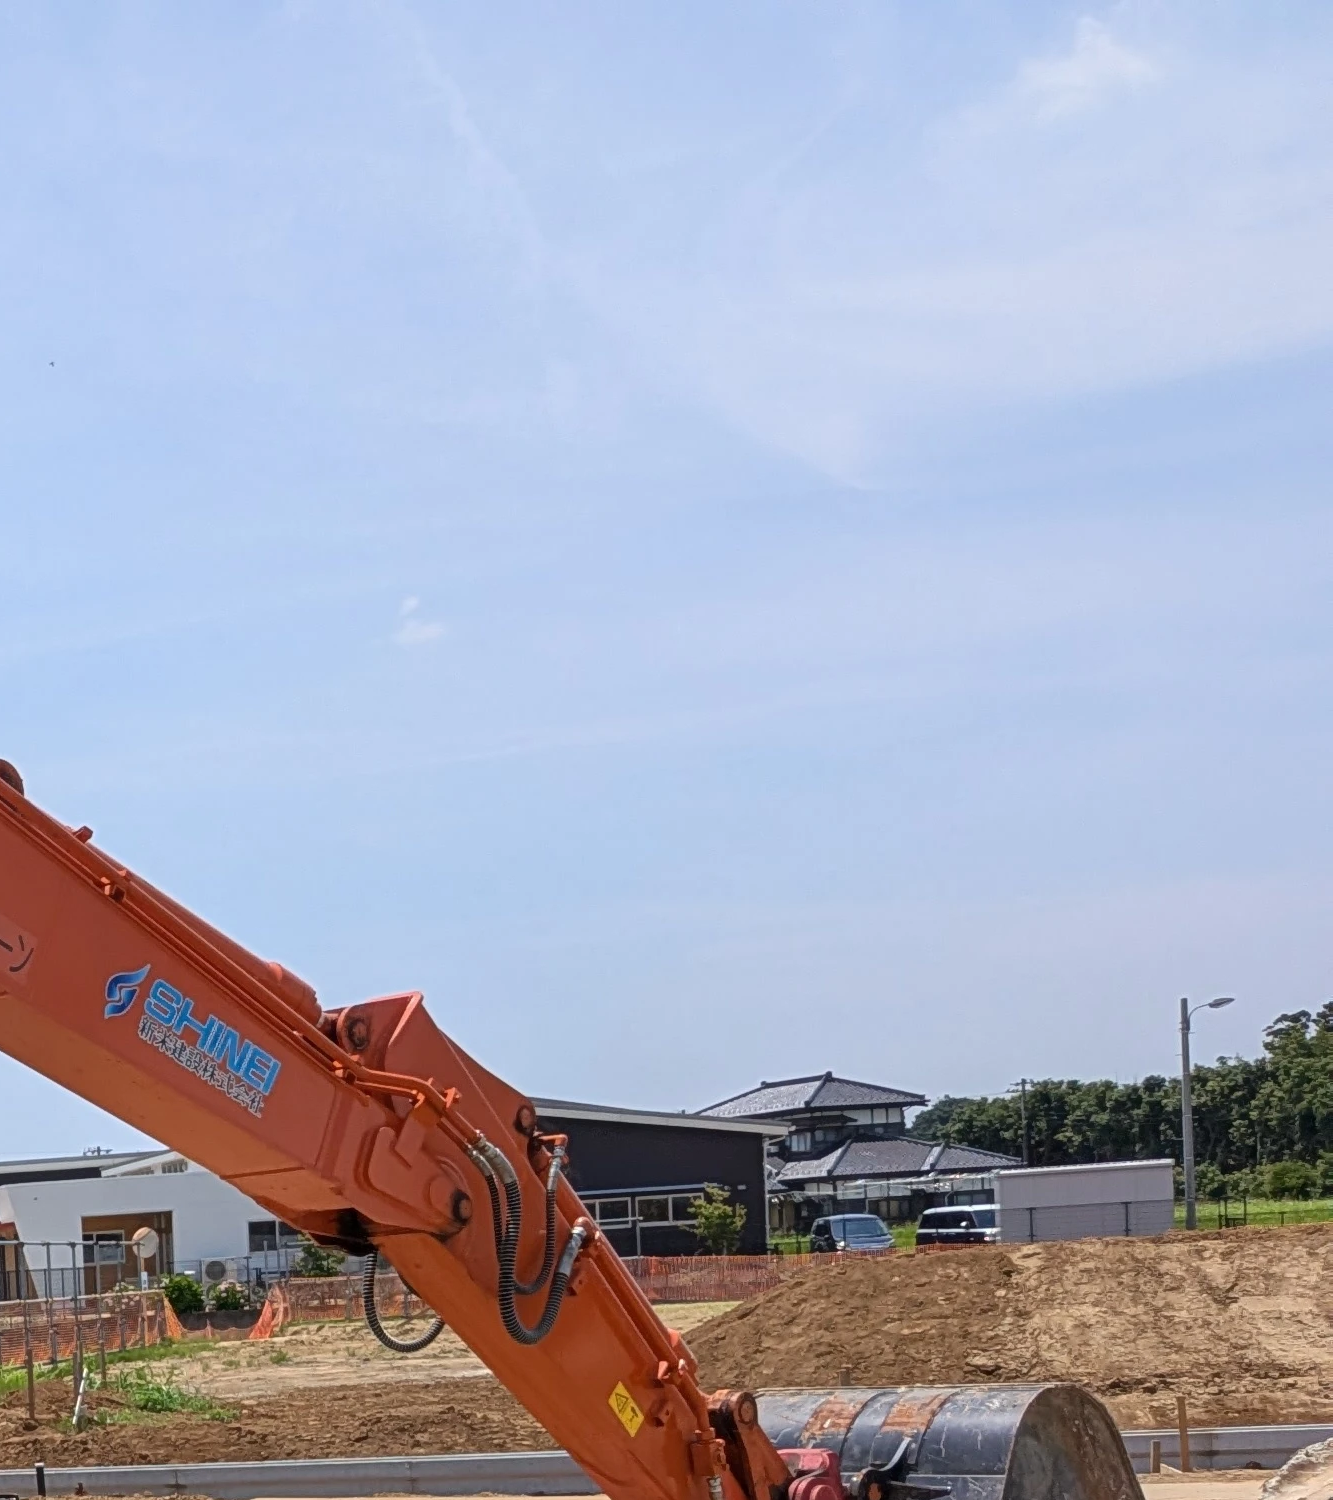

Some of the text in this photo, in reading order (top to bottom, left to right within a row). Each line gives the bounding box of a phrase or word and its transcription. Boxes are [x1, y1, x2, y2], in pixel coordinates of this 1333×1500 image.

[138, 1015, 265, 1118] 新栄建設株式会社
[144, 979, 281, 1095] SHINEI
